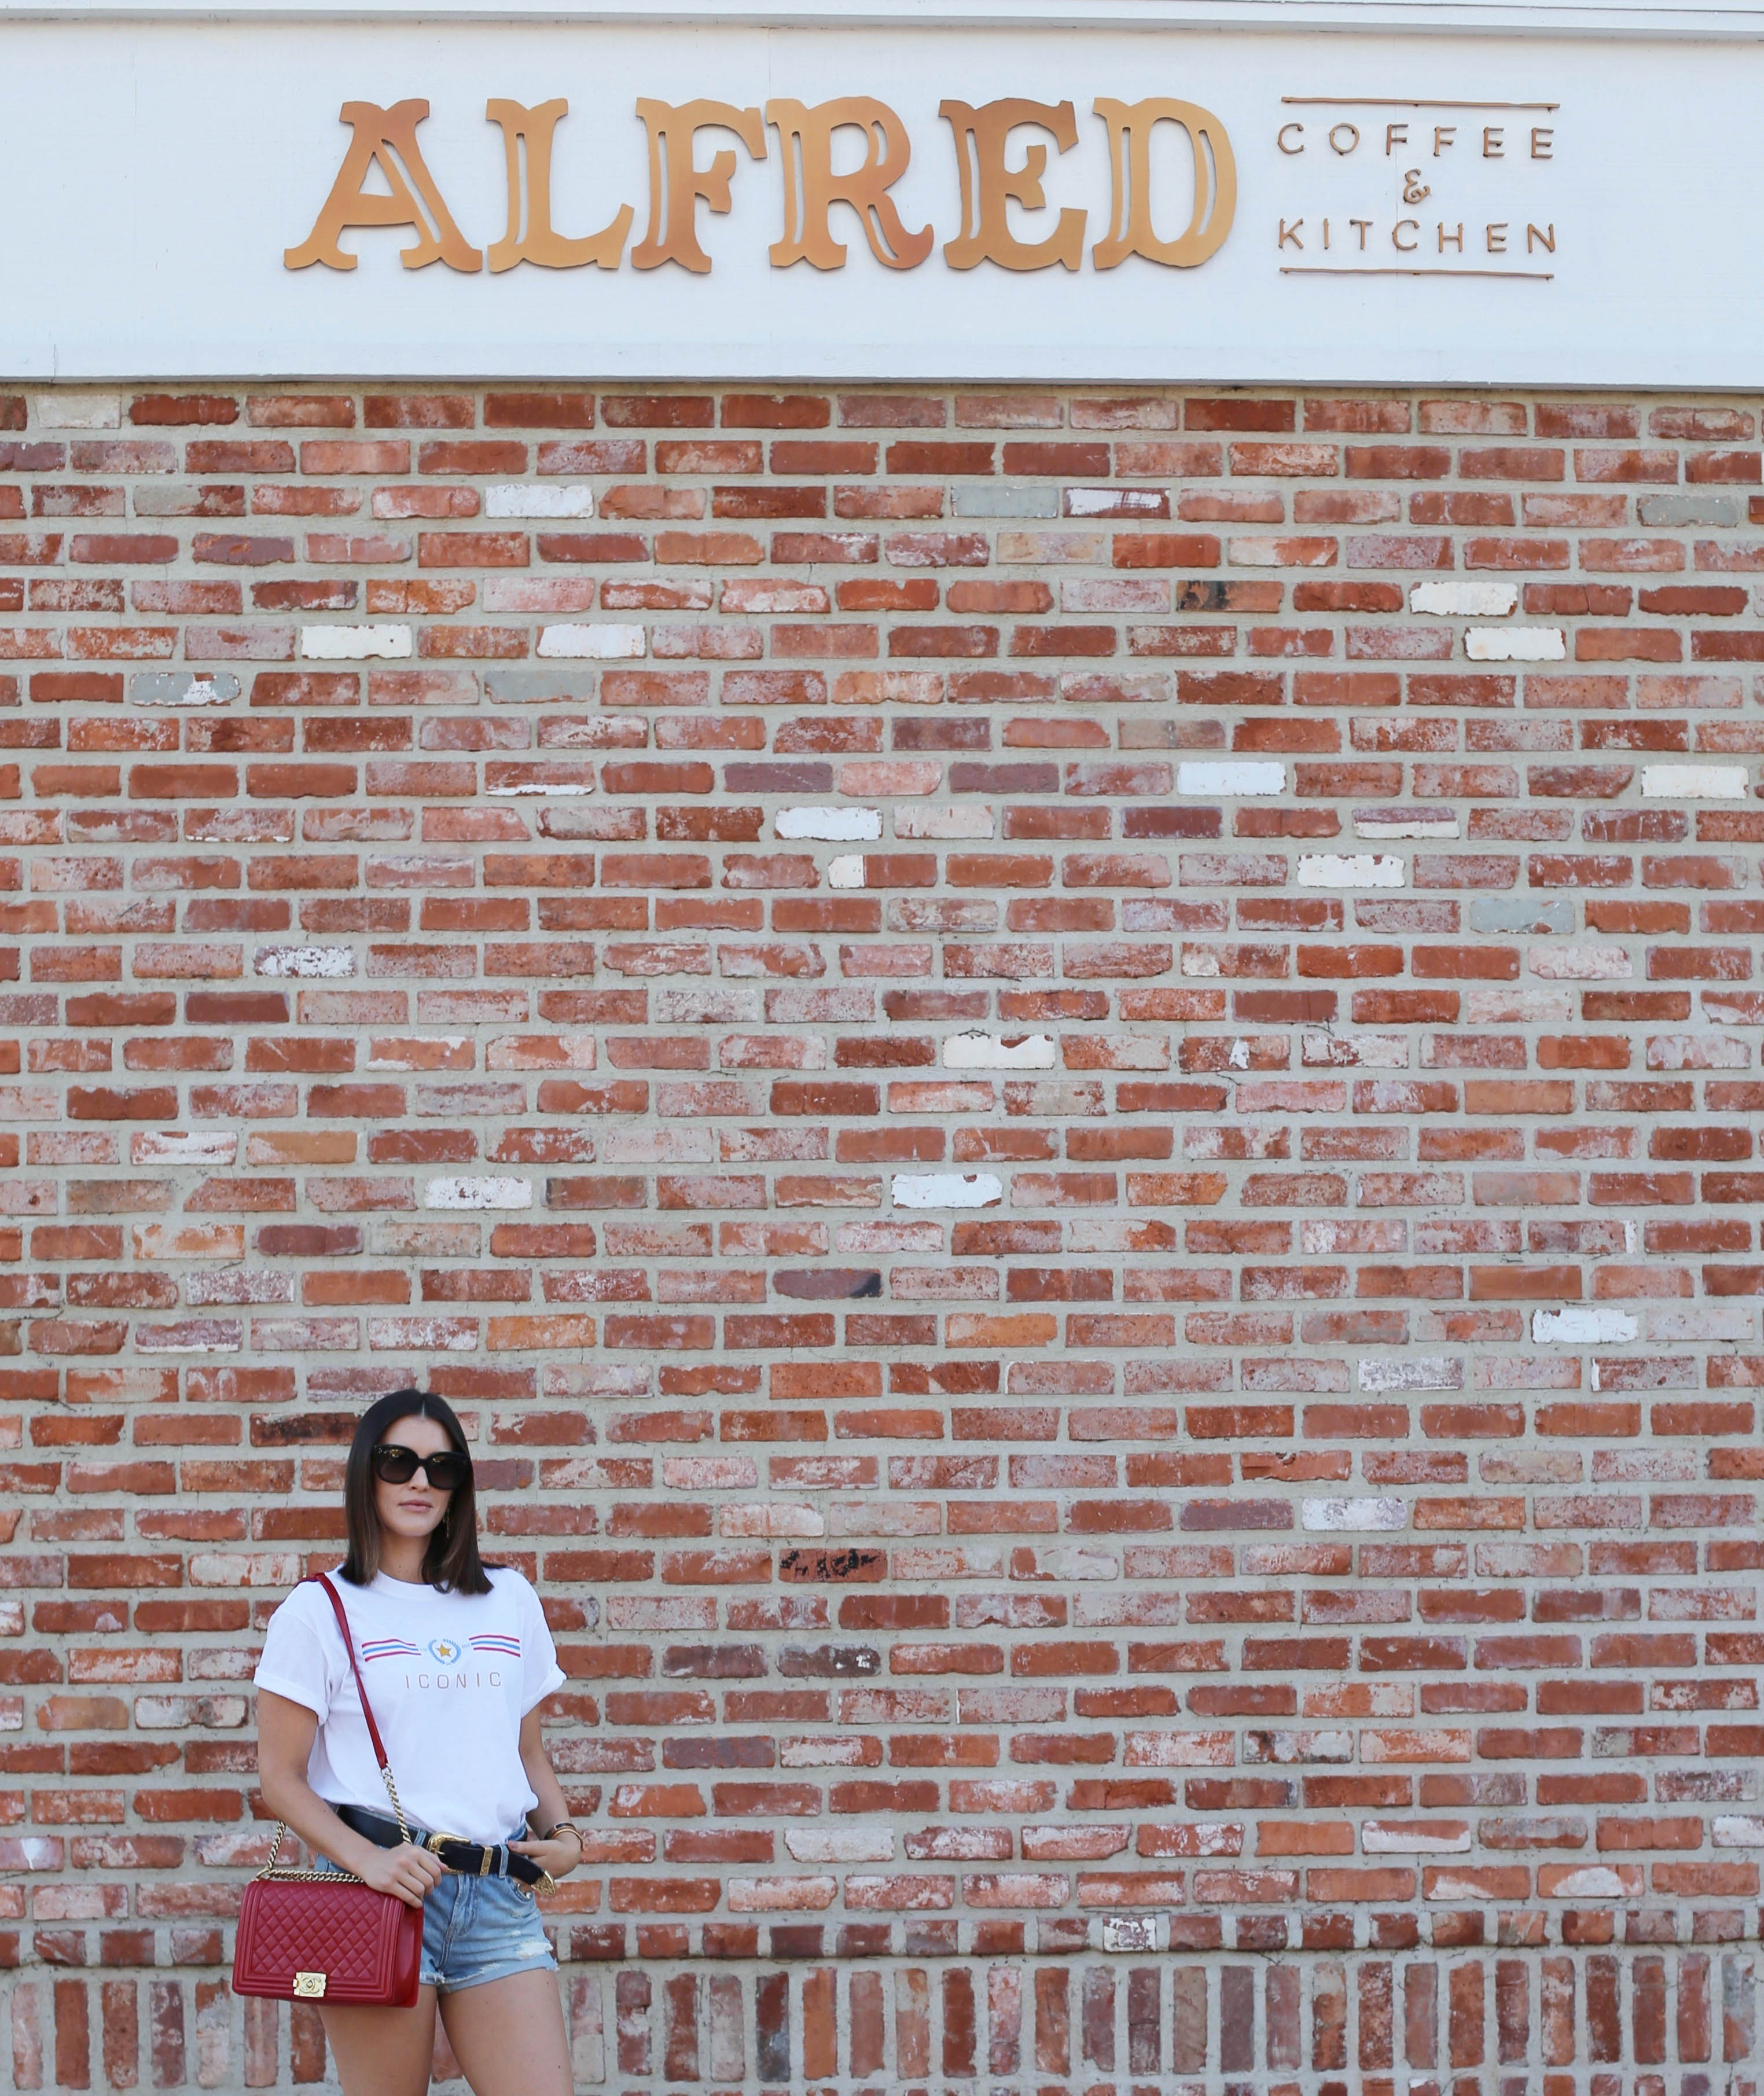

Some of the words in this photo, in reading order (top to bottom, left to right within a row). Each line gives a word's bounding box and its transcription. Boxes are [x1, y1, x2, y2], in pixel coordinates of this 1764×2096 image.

[1277, 122, 1554, 159] COFFEE
[284, 95, 1237, 275] ALFRED
[1403, 168, 1431, 205] &
[1278, 218, 1557, 253] KITCHEN
[405, 1672, 501, 1689] ICONIC
